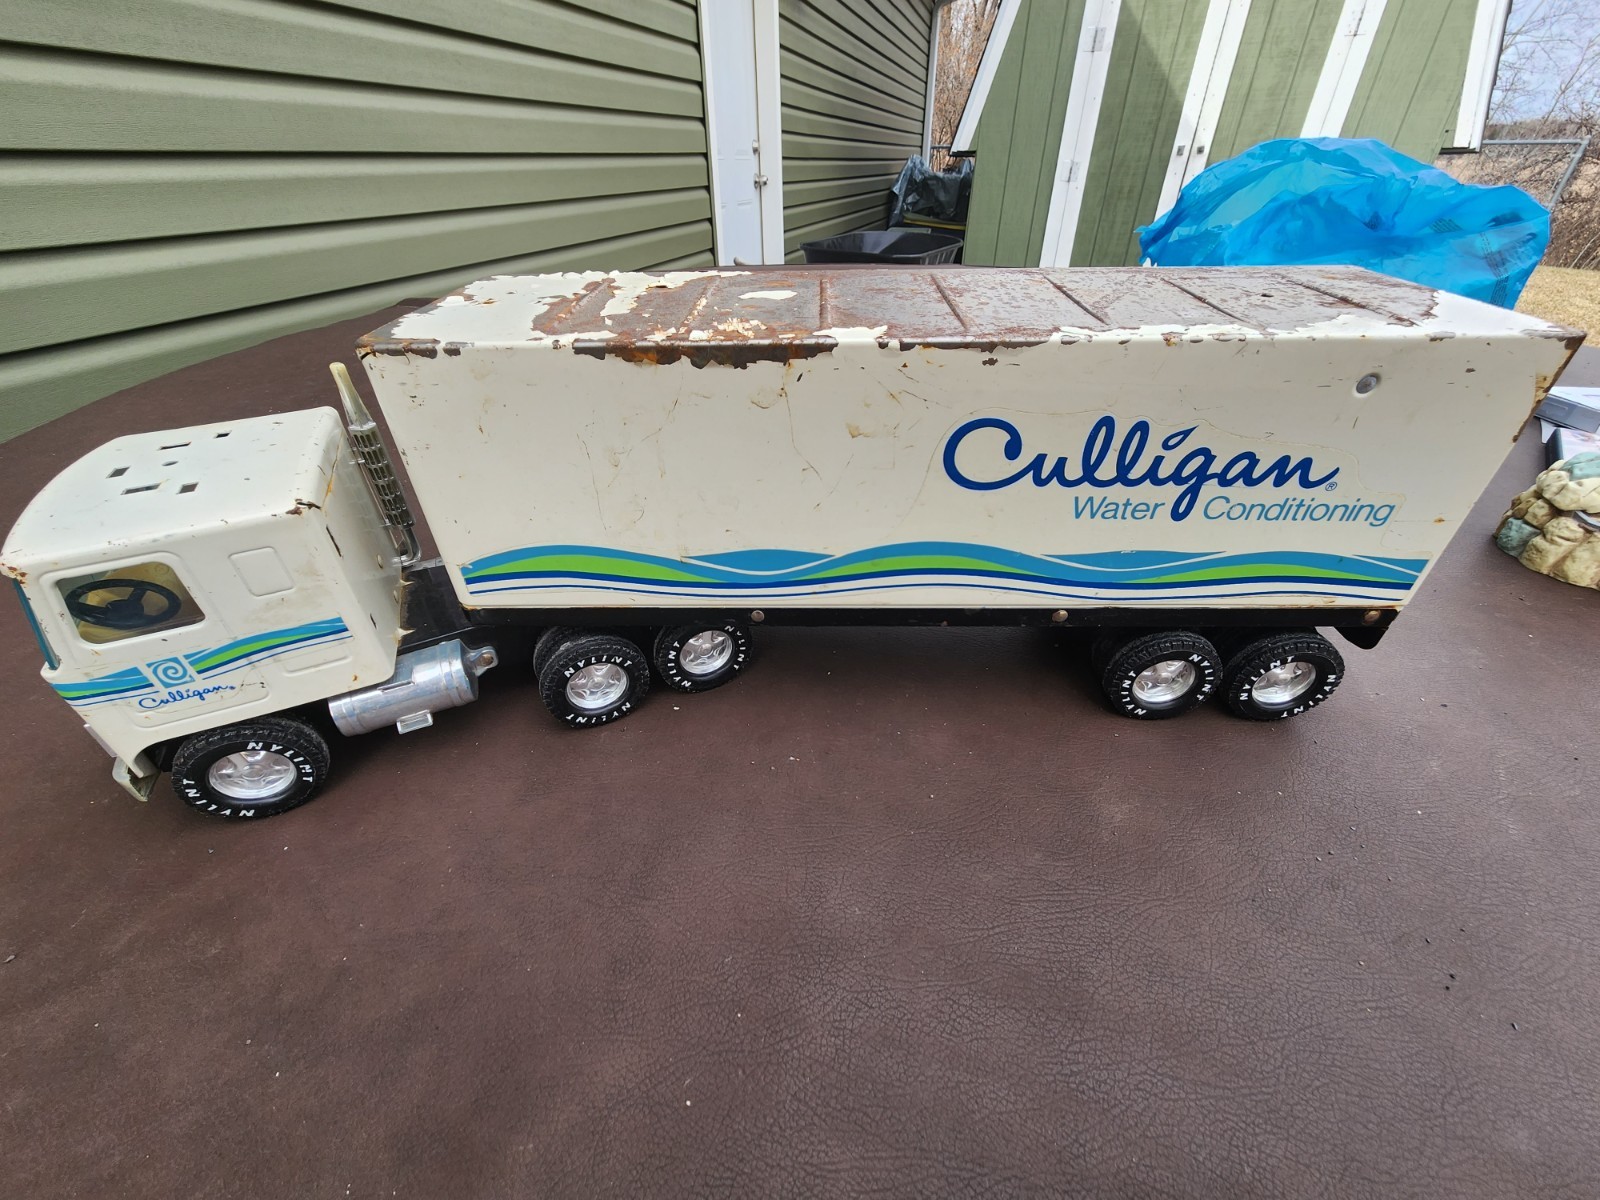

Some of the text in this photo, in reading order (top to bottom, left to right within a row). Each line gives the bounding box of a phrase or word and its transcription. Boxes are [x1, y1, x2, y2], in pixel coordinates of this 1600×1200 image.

[943, 416, 1340, 522] Culligan
[1073, 496, 1396, 527] Water Conditioning
[564, 655, 633, 678] NYLINT
[668, 641, 691, 687] NYLINT
[1189, 653, 1214, 701] NYLINT
[1240, 656, 1295, 700] NYLINT
[138, 686, 229, 709] Culligan
[566, 702, 631, 724] NYLINT
[1121, 671, 1147, 716] NYLINT
[1281, 674, 1336, 718] NYLINT
[247, 742, 313, 783] NYLINT
[183, 779, 255, 818] NYLINT
